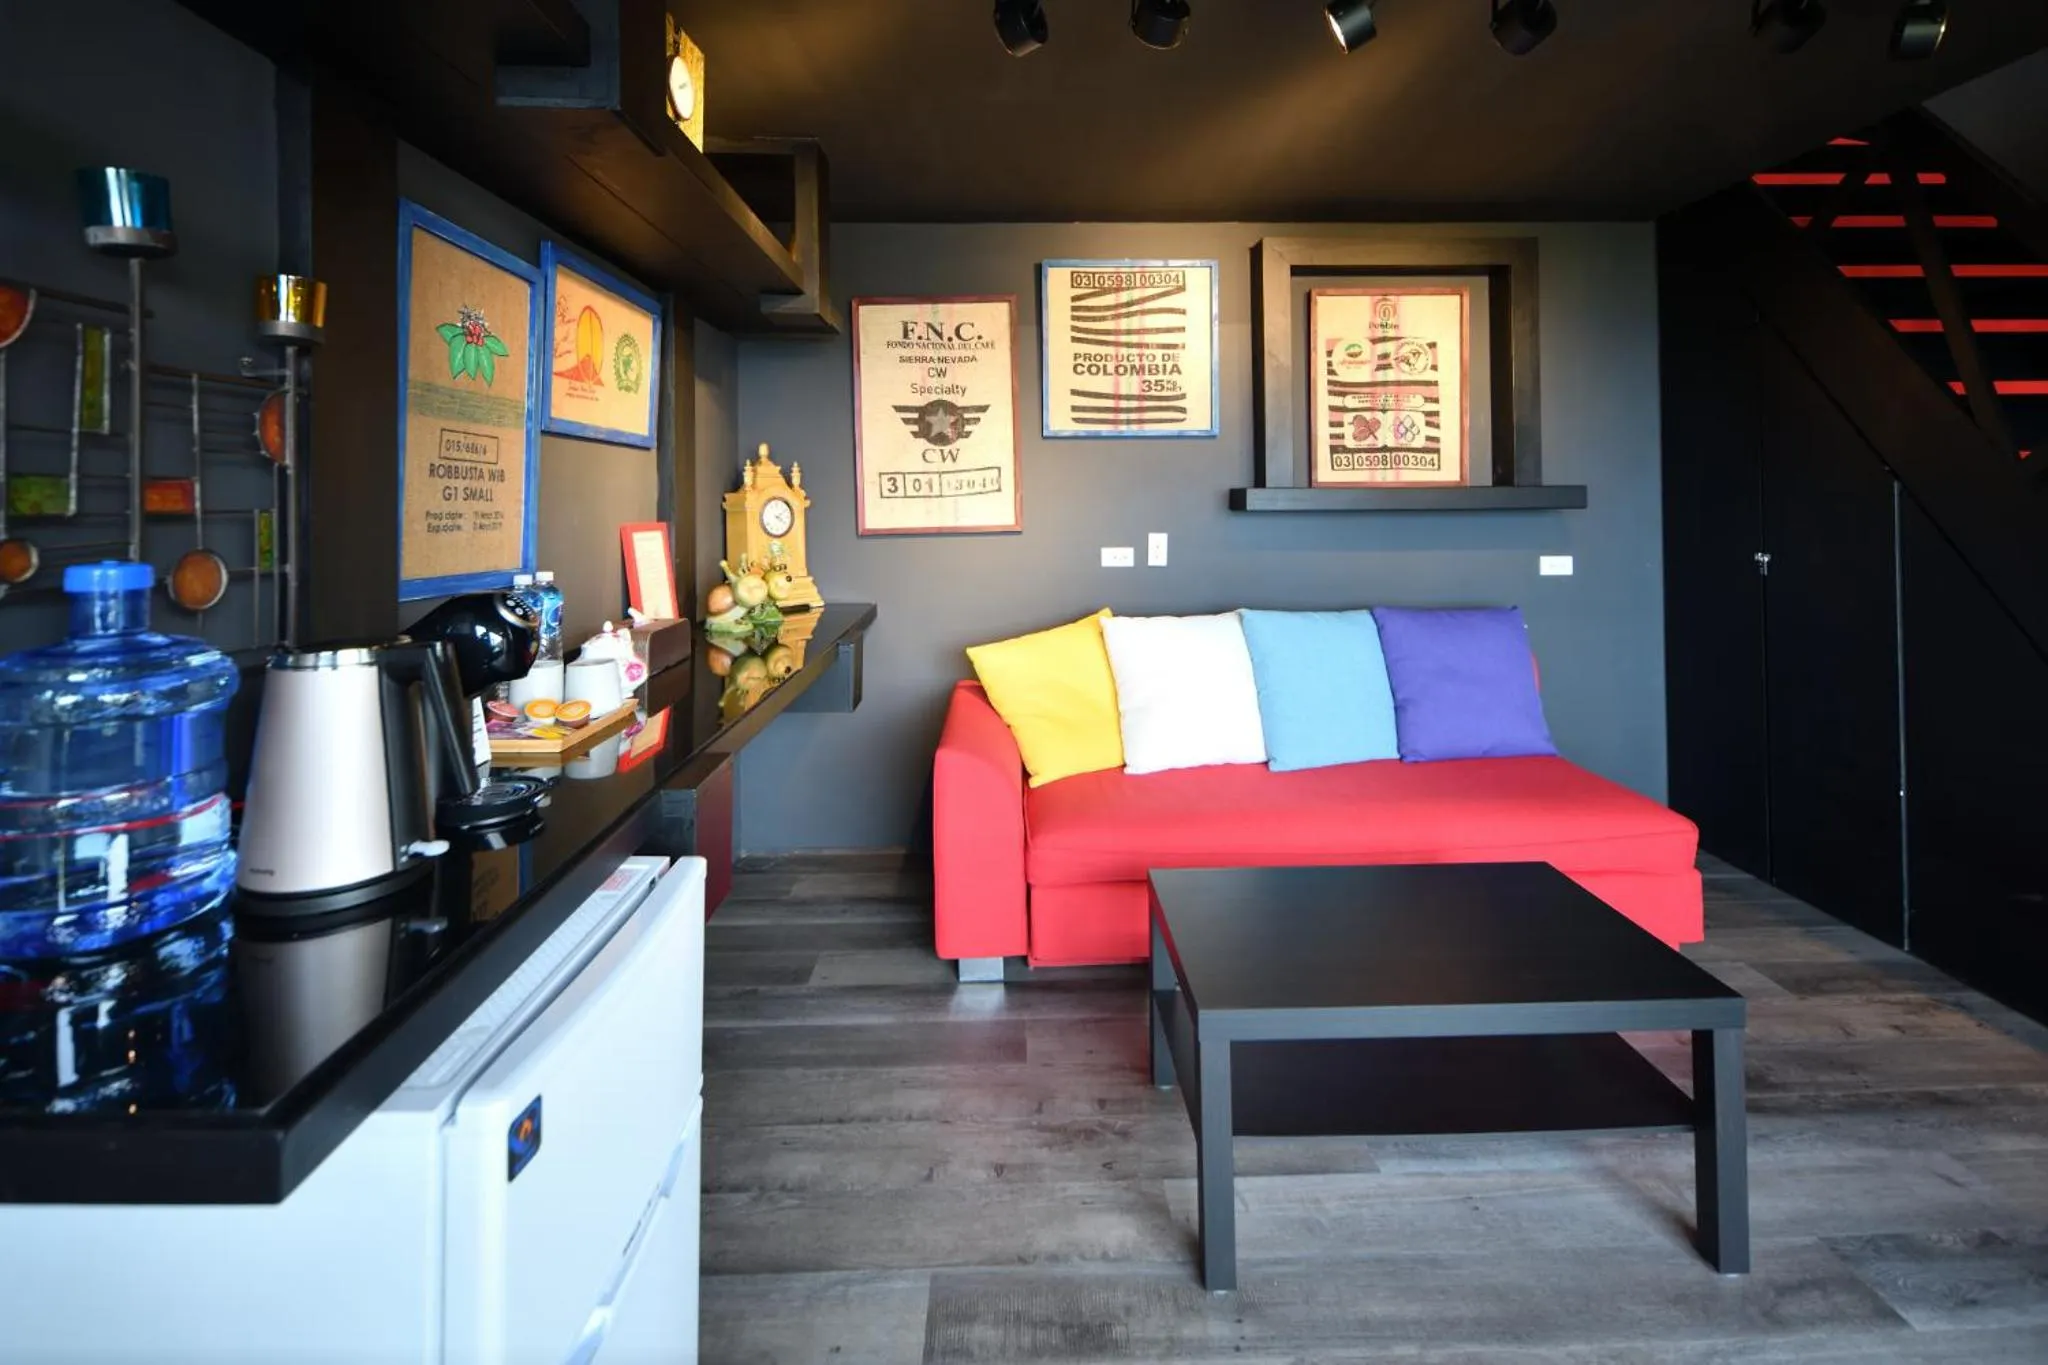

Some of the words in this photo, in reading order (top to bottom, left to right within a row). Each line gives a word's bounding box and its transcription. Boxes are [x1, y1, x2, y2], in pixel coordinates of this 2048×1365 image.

[1075, 274, 1092, 287] 03
[1097, 274, 1133, 287] 0598
[1139, 273, 1181, 286] 00304
[901, 320, 984, 343] F.N.C.
[886, 340, 915, 350] FONDO
[916, 341, 956, 351] NACIONAL
[898, 355, 936, 364] SIERRA
[937, 355, 978, 364] NEVADA
[1073, 352, 1157, 363] PRODUCTO
[1161, 352, 1181, 363] DE
[927, 366, 948, 379] CW
[1072, 363, 1183, 376] COLOMBIA
[910, 382, 967, 398] Specialty
[1141, 379, 1165, 393] 35
[922, 448, 961, 464] CW
[1335, 455, 1351, 468] 03
[1356, 455, 1389, 467] 0598
[1393, 454, 1436, 468] 00304
[428, 463, 486, 481] ROBBUSTA
[887, 476, 899, 494] 3
[462, 486, 493, 502] SMALL
